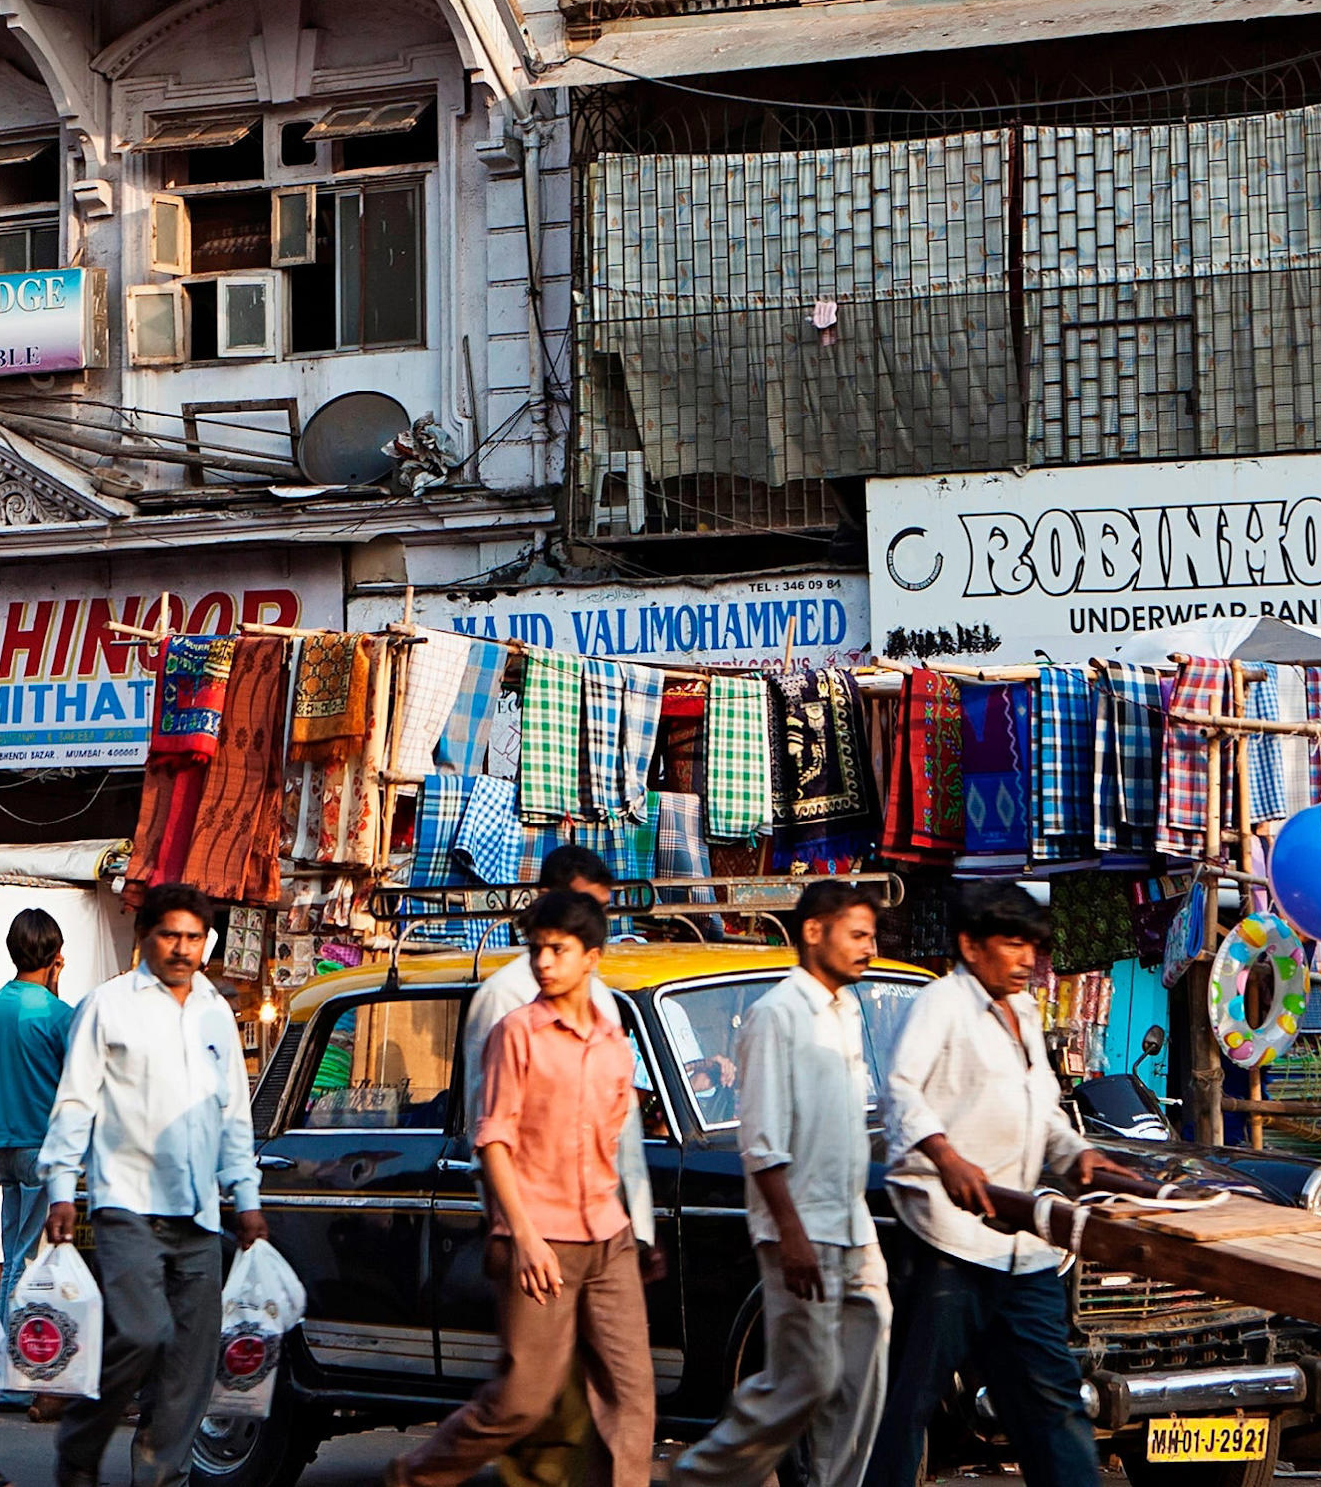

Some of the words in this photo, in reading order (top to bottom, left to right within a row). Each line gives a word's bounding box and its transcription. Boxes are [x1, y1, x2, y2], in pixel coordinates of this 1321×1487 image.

[782, 580, 805, 591] 346
[808, 580, 824, 590] 09
[572, 598, 847, 656] VALIMOHAMMED
[1151, 1427, 1266, 1455] MH-01-J-2921
